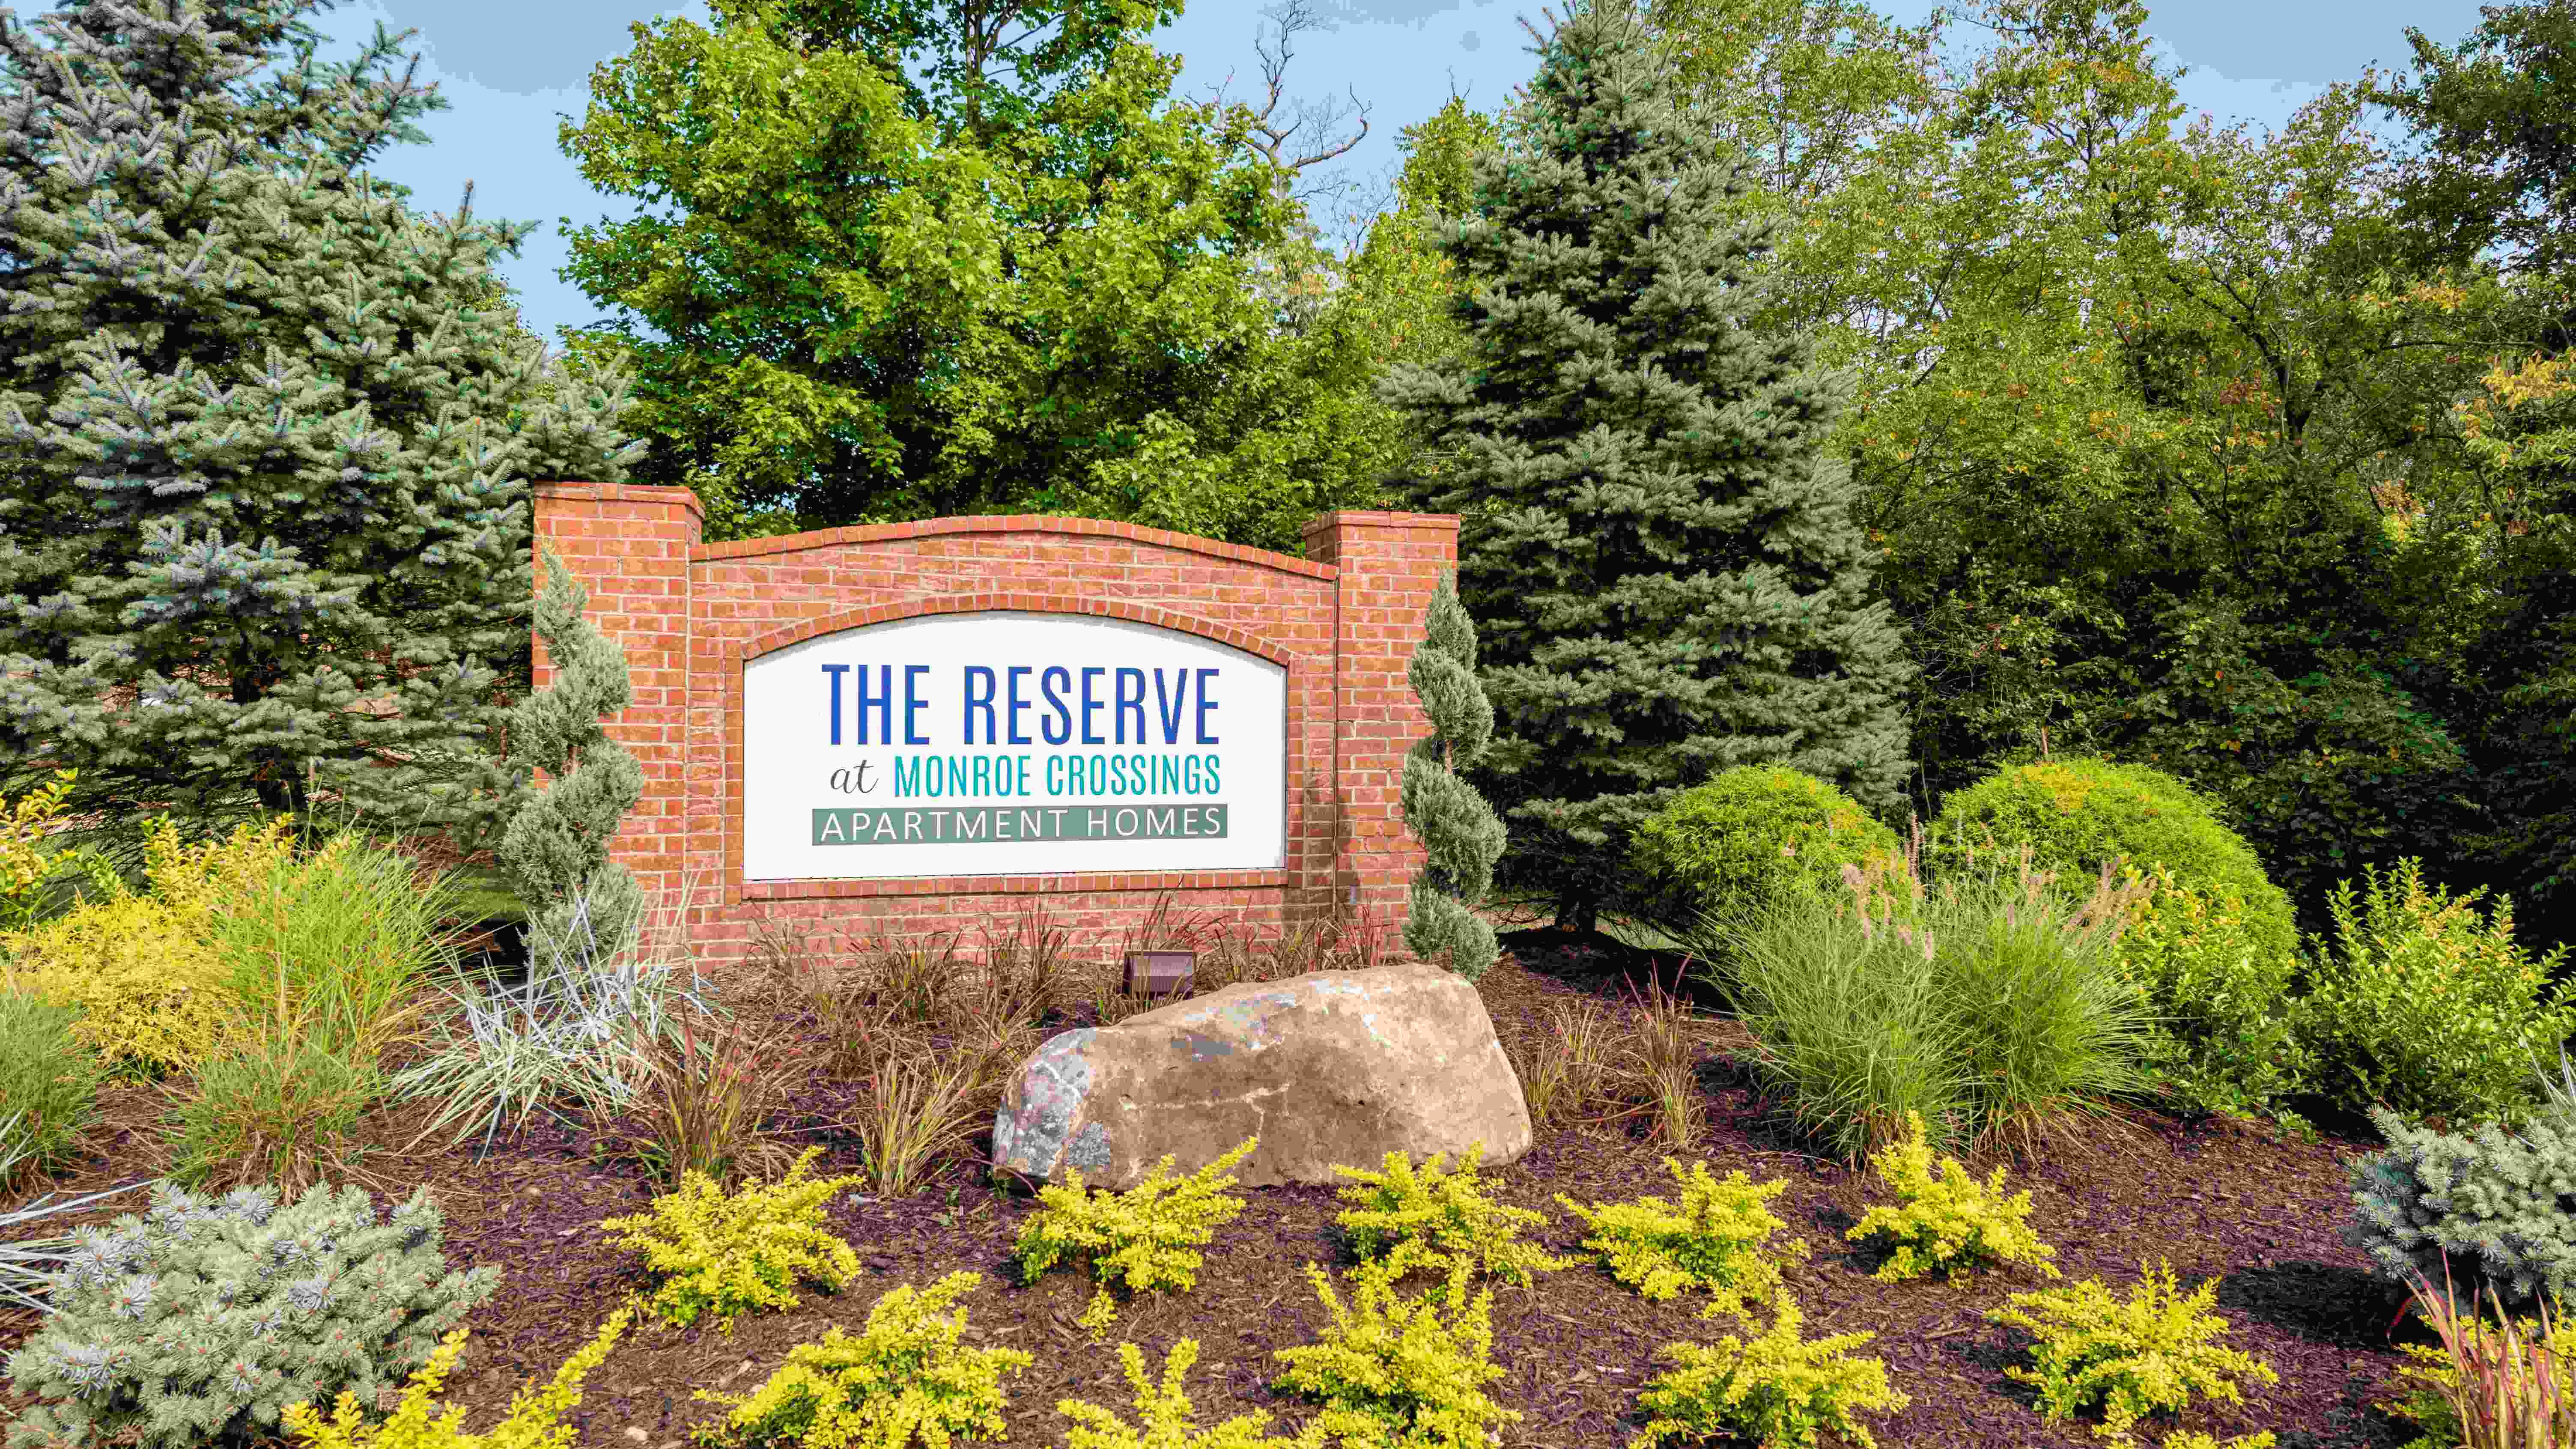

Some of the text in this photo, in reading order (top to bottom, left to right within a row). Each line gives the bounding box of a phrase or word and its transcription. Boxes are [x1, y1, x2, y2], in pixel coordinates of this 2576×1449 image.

[822, 664, 1219, 745] THE RESERVE
[830, 754, 1220, 798] at MONROE CROSSINGS
[820, 806, 1221, 843] APARTMENT HOMES
